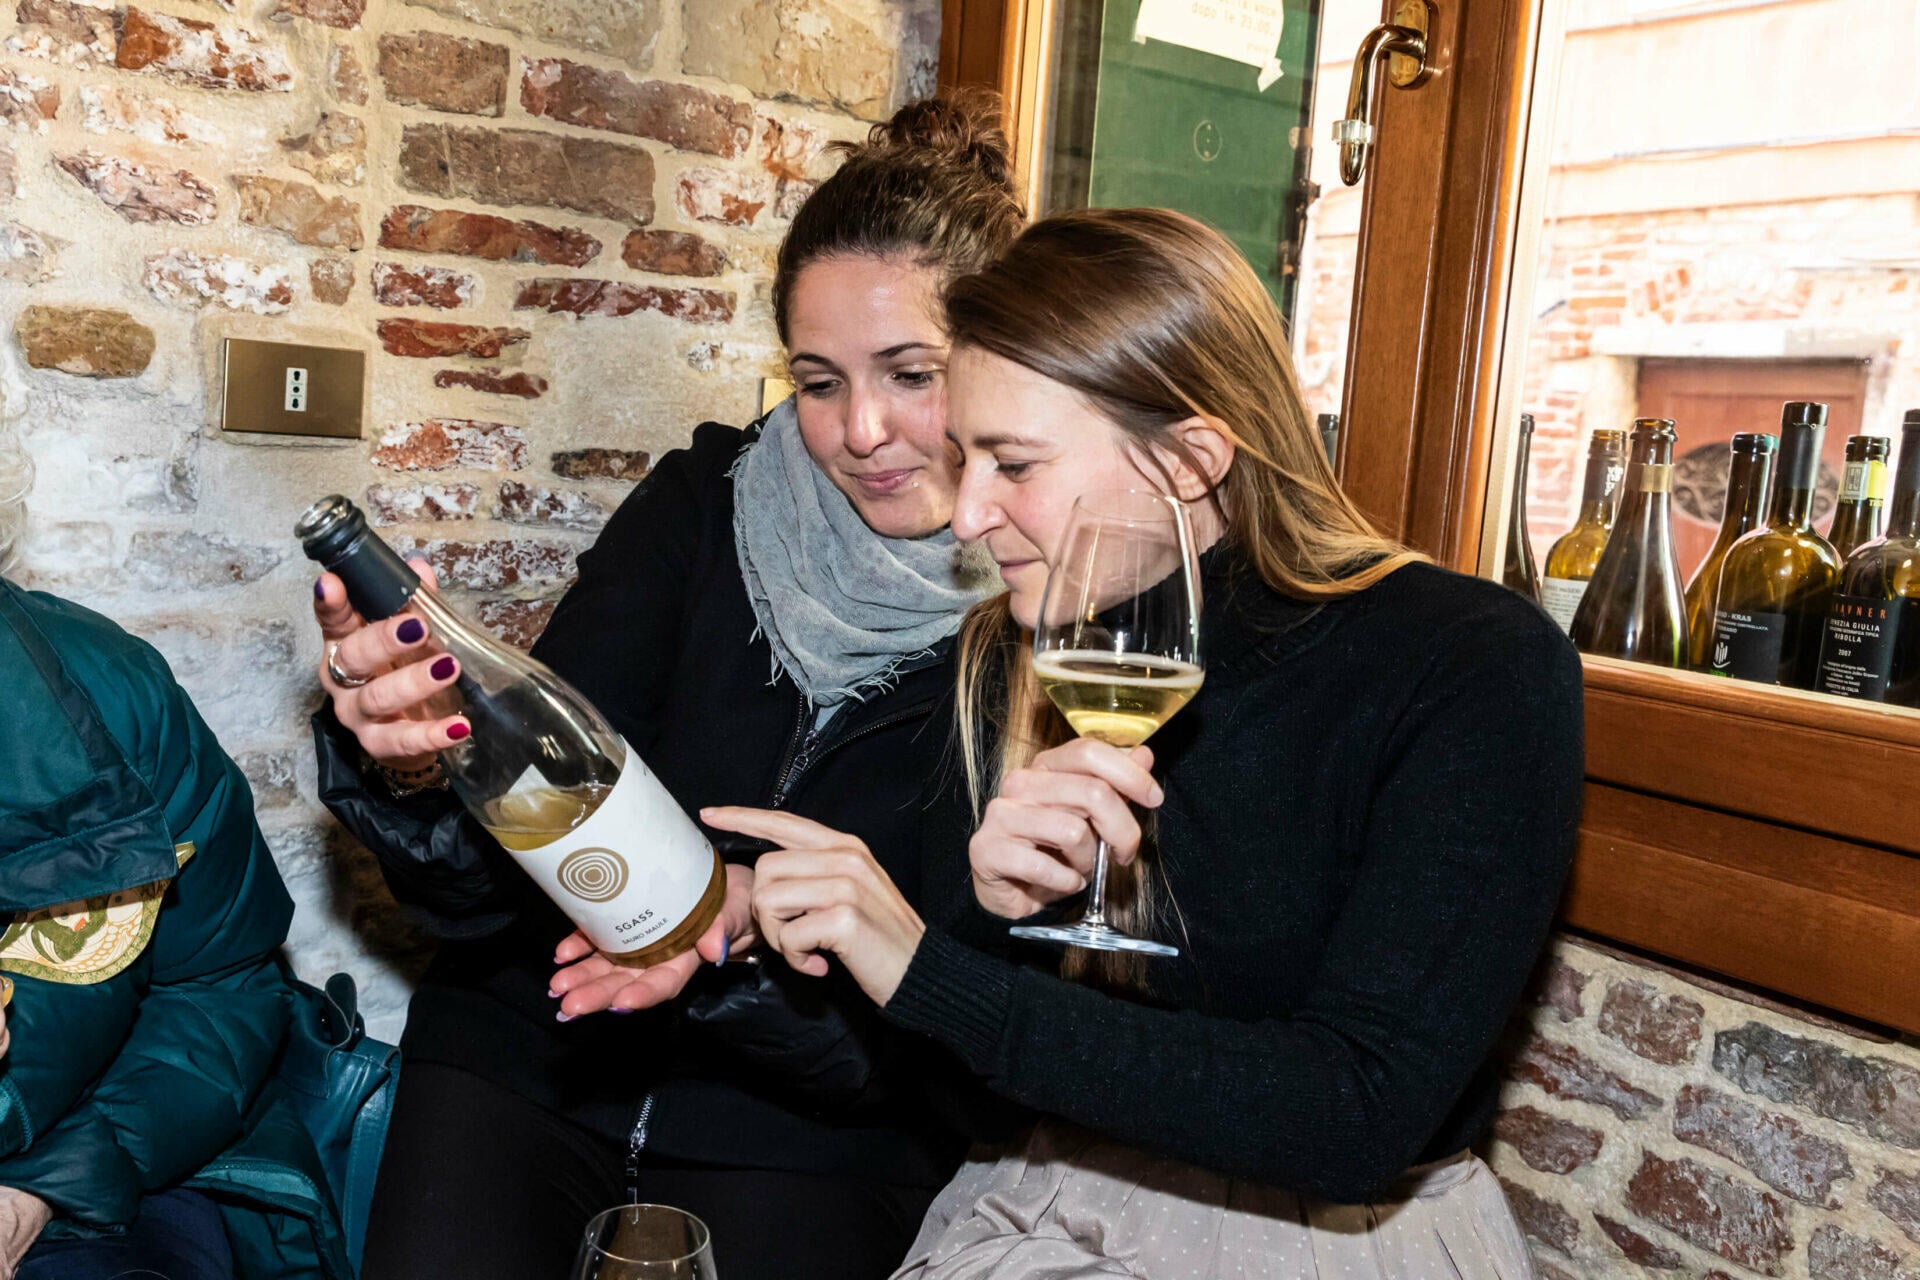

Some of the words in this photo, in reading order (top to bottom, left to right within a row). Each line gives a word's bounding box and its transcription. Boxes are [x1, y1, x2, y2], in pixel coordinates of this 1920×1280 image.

[1191, 1, 1217, 19] dopo
[1731, 613, 1752, 623] KRAS
[1852, 621, 1881, 632] GIULIA
[1834, 632, 1862, 643] RIBOLLA
[1838, 648, 1852, 657] 2007
[615, 908, 654, 933] SGASS
[645, 917, 668, 935] MAULE
